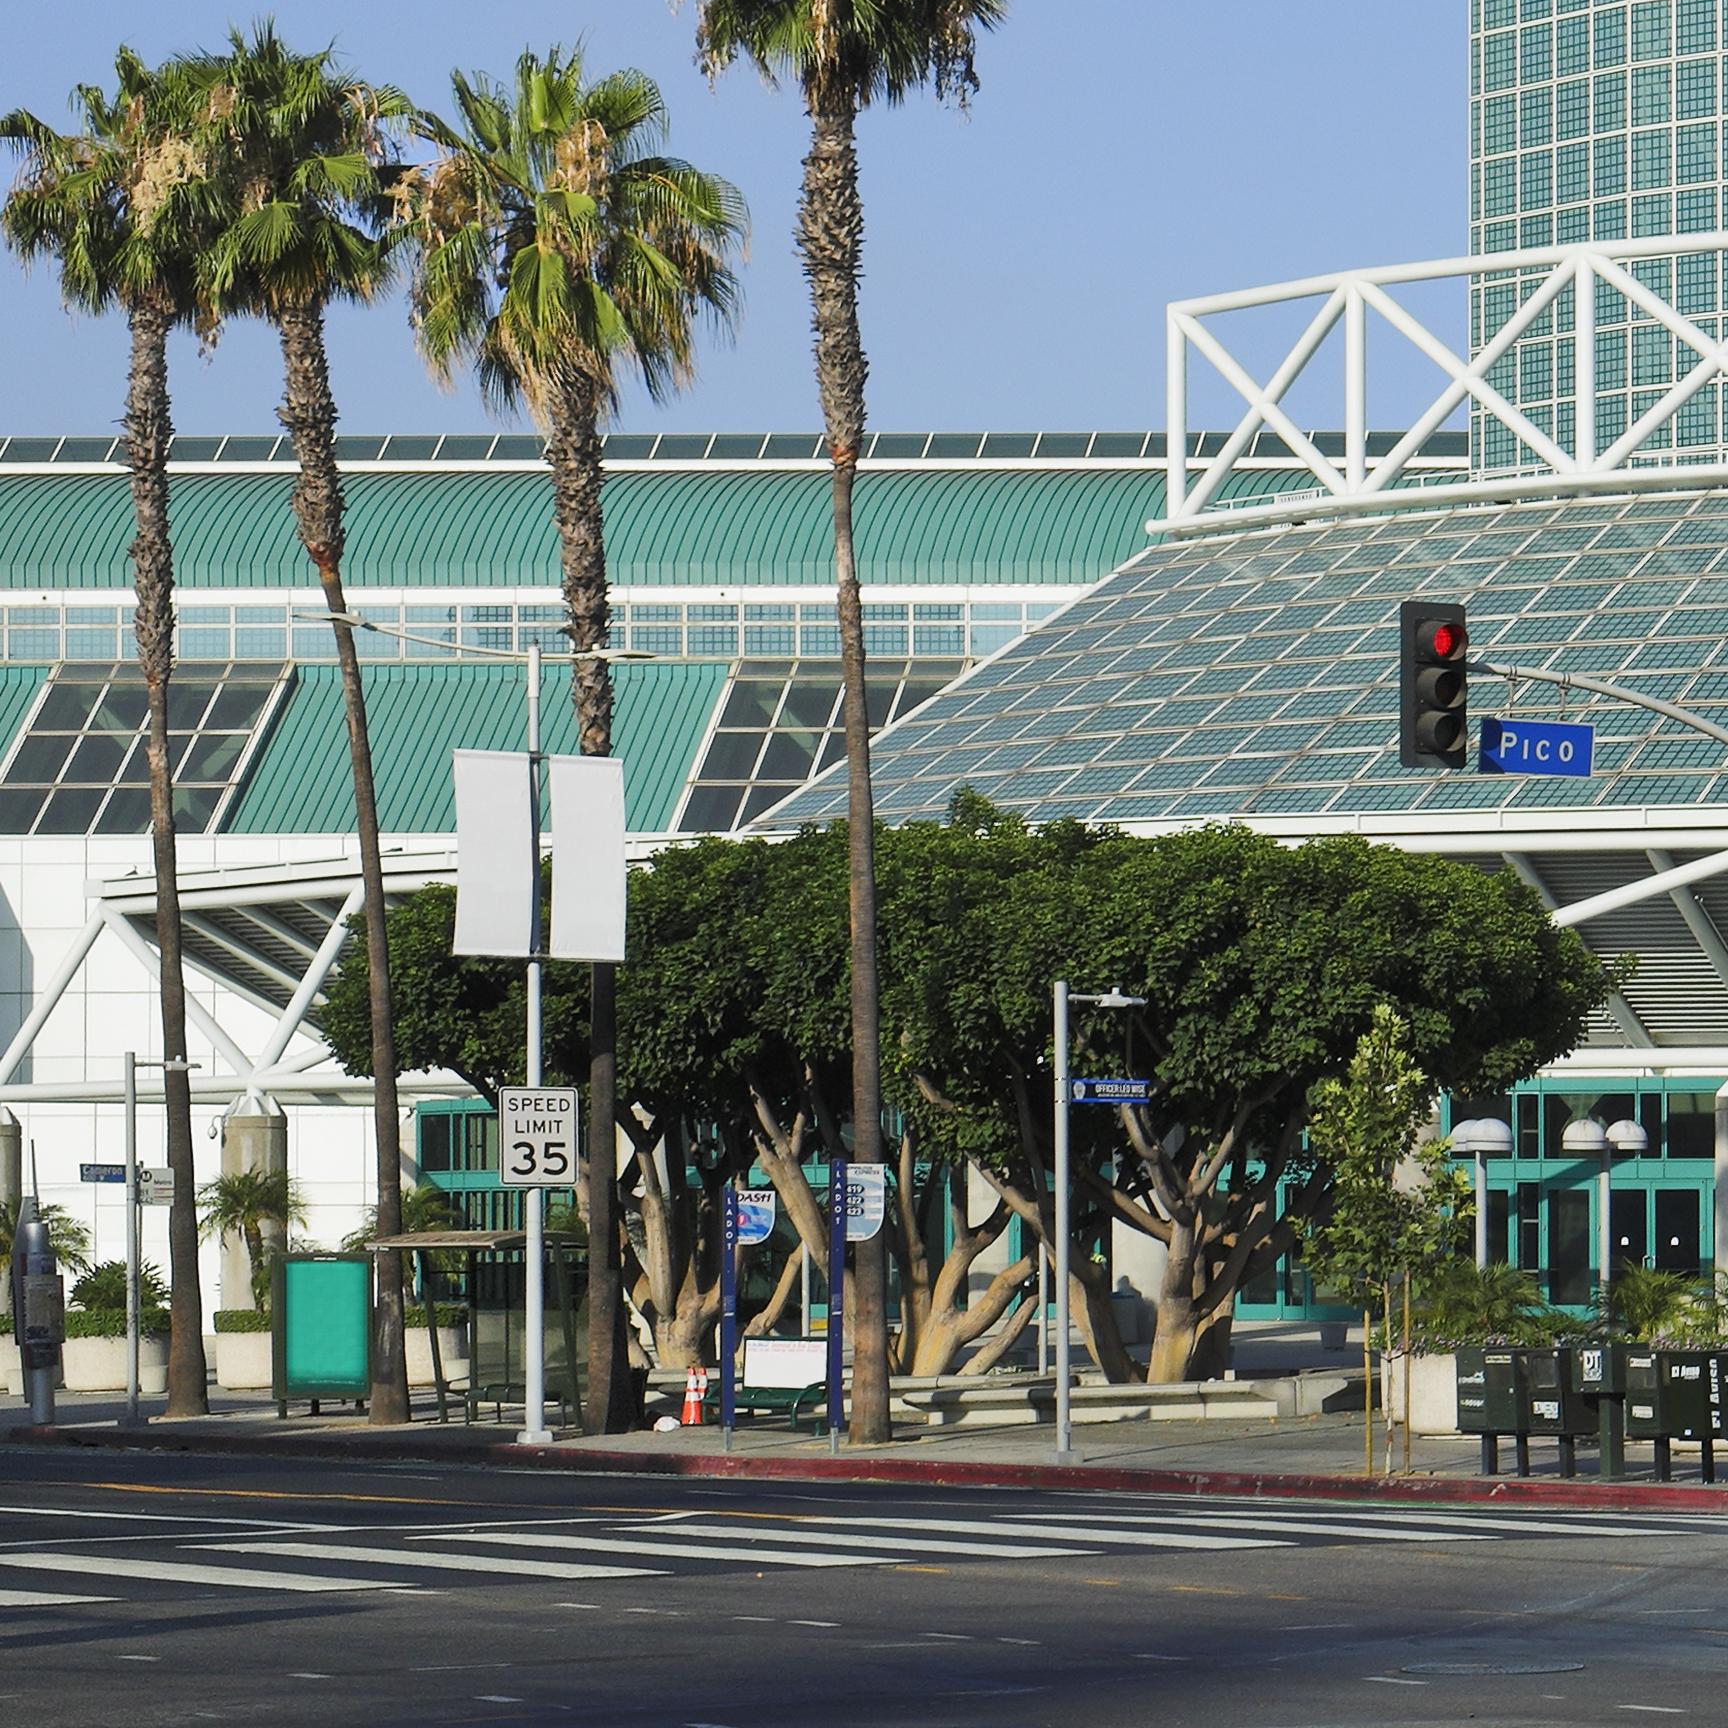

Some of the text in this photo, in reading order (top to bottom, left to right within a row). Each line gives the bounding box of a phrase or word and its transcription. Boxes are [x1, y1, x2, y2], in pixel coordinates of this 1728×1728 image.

[508, 1097, 570, 1112] SPEED
[515, 1119, 563, 1134] LIMIT
[511, 1141, 568, 1175] 35
[737, 1193, 772, 1203] DASH
[834, 1170, 842, 1225] LADOT
[726, 1197, 734, 1251] LADOT
